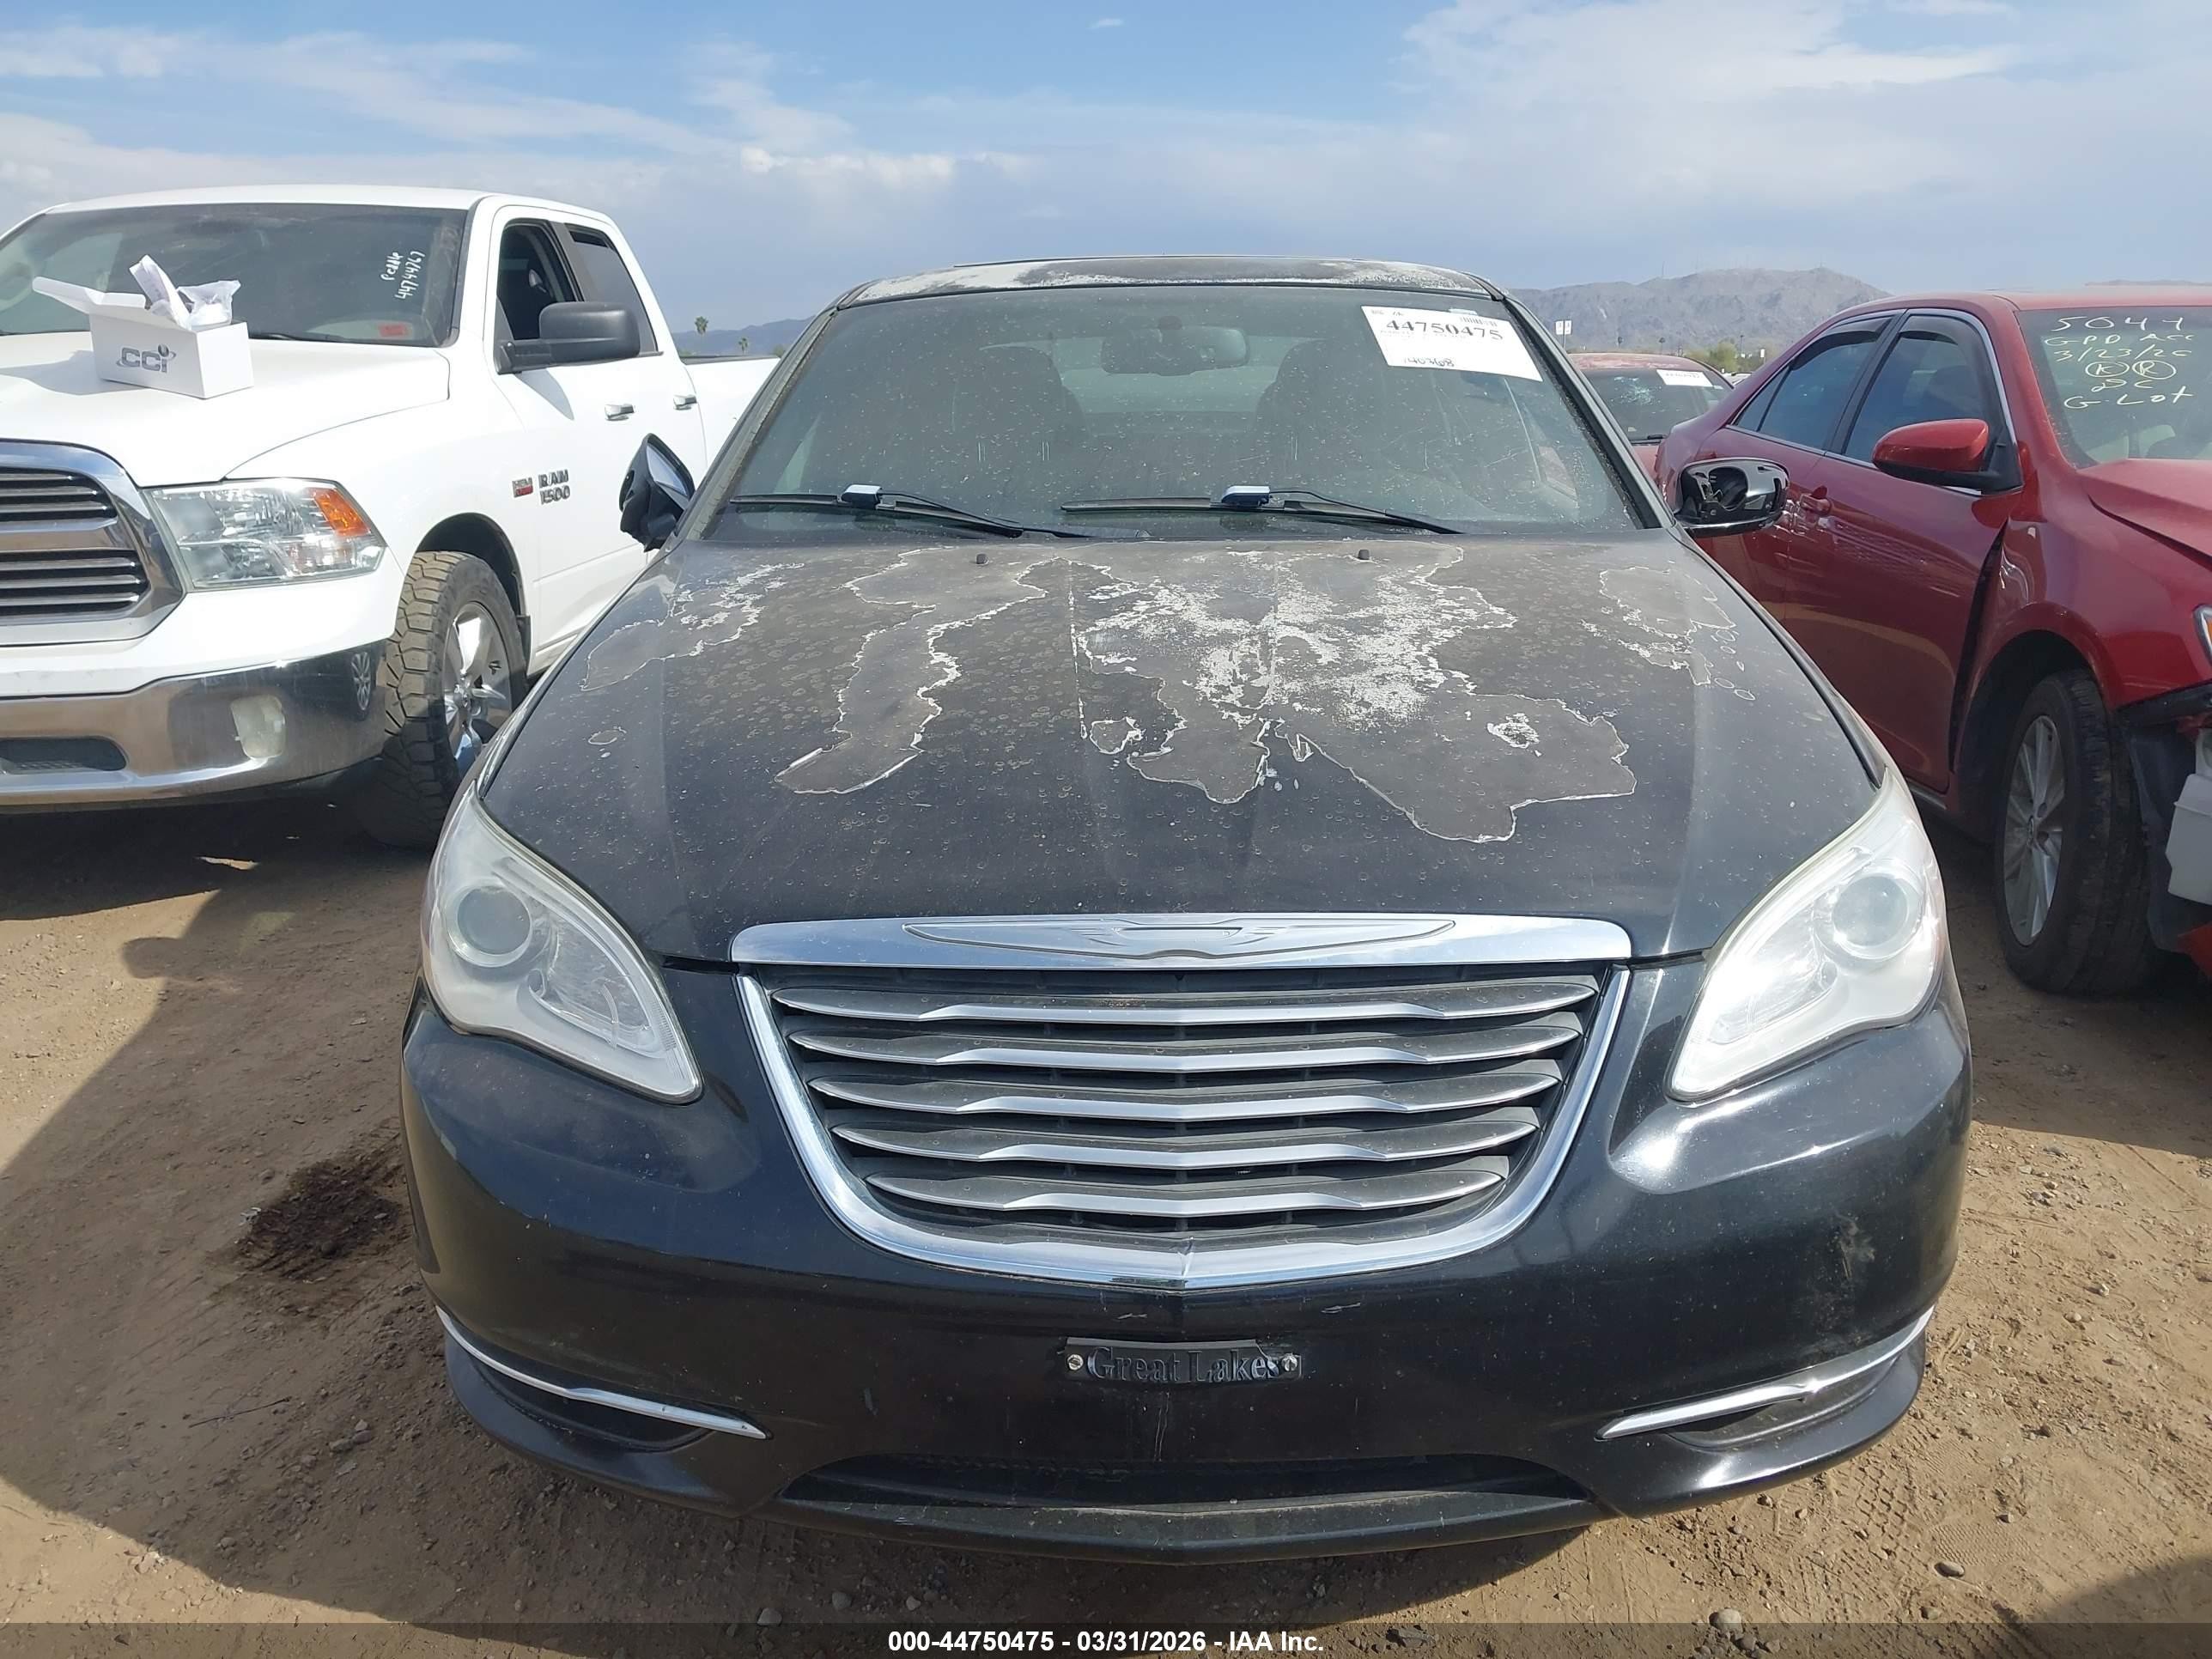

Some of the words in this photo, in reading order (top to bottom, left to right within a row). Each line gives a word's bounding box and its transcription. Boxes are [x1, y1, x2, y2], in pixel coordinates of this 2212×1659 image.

[1386, 319, 1504, 340] 44750475
[538, 469, 568, 489] RAM
[540, 485, 571, 505] 1500
[1087, 1346, 1181, 1382] Great
[1188, 1348, 1279, 1382] Lakes
